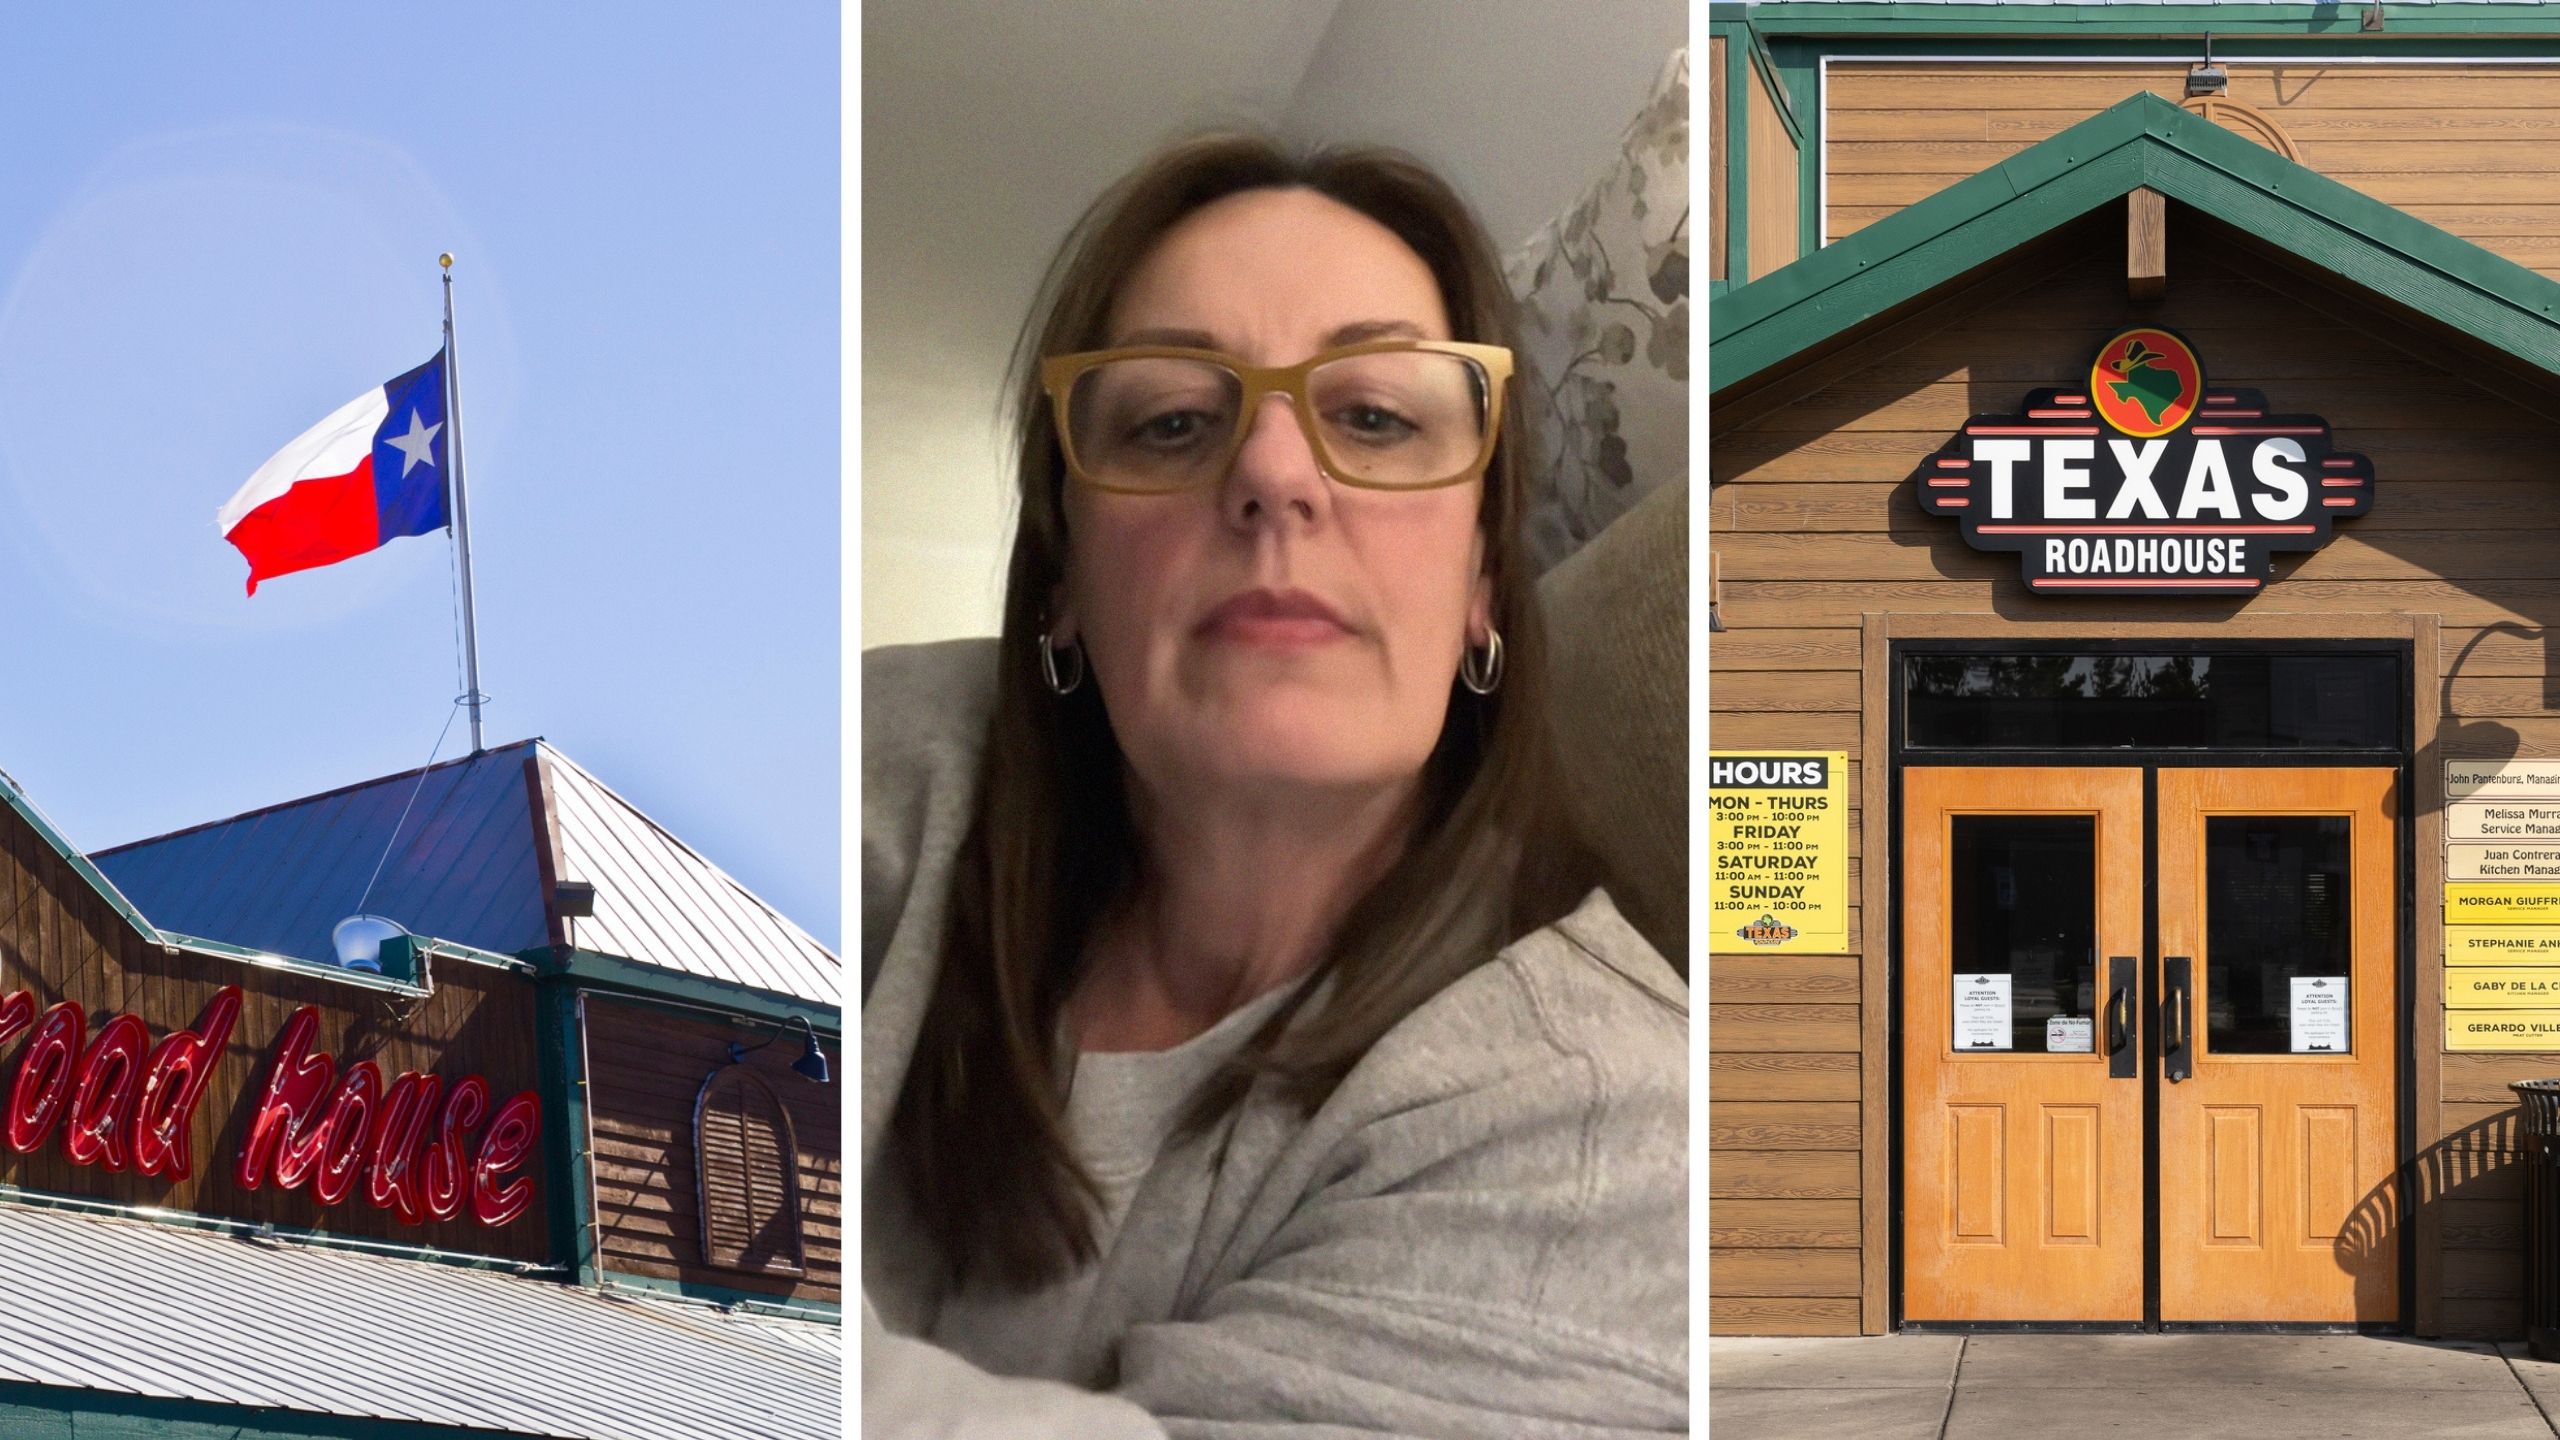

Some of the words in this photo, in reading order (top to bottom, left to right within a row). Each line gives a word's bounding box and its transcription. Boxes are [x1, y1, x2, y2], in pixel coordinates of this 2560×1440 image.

[1973, 437, 2309, 521] TEXAS
[2045, 538, 2246, 574] ROADHOUSE
[1712, 762, 1822, 785] HOURS
[2449, 773, 2470, 784] John
[1709, 796, 1749, 809] MON
[1767, 796, 1829, 810] THURS
[1716, 812, 1744, 821] 3:00
[1772, 812, 1805, 821] 10:00
[2484, 808, 2525, 819] Melissa
[1734, 825, 1801, 838] FRIDAY
[2481, 823, 2521, 834] Service
[1717, 841, 1744, 850] 3:00
[1773, 841, 1803, 850] 11:00
[2484, 849, 2509, 860] Juan
[1718, 856, 1818, 869] SATURDAY
[2480, 864, 2520, 875] Kitchen
[1715, 871, 1745, 880] 11:00
[1774, 871, 1804, 880] 11:00
[1729, 885, 1805, 898] SUNDAY
[1714, 901, 1744, 910] 11:00
[1773, 901, 1806, 910] 10:00
[2459, 897, 2512, 905] MORGAN
[2516, 897, 2560, 905] GIUFFR
[1745, 927, 1790, 939] TEXAS
[2468, 939, 2535, 948] STEPHANIE
[2473, 982, 2506, 991] GABY
[2511, 982, 2526, 991] DE
[2531, 982, 2547, 991] LA
[2551, 982, 2560, 991] C
[2467, 1024, 2526, 1032] GERARDO
[235, 1004, 543, 1227] house
